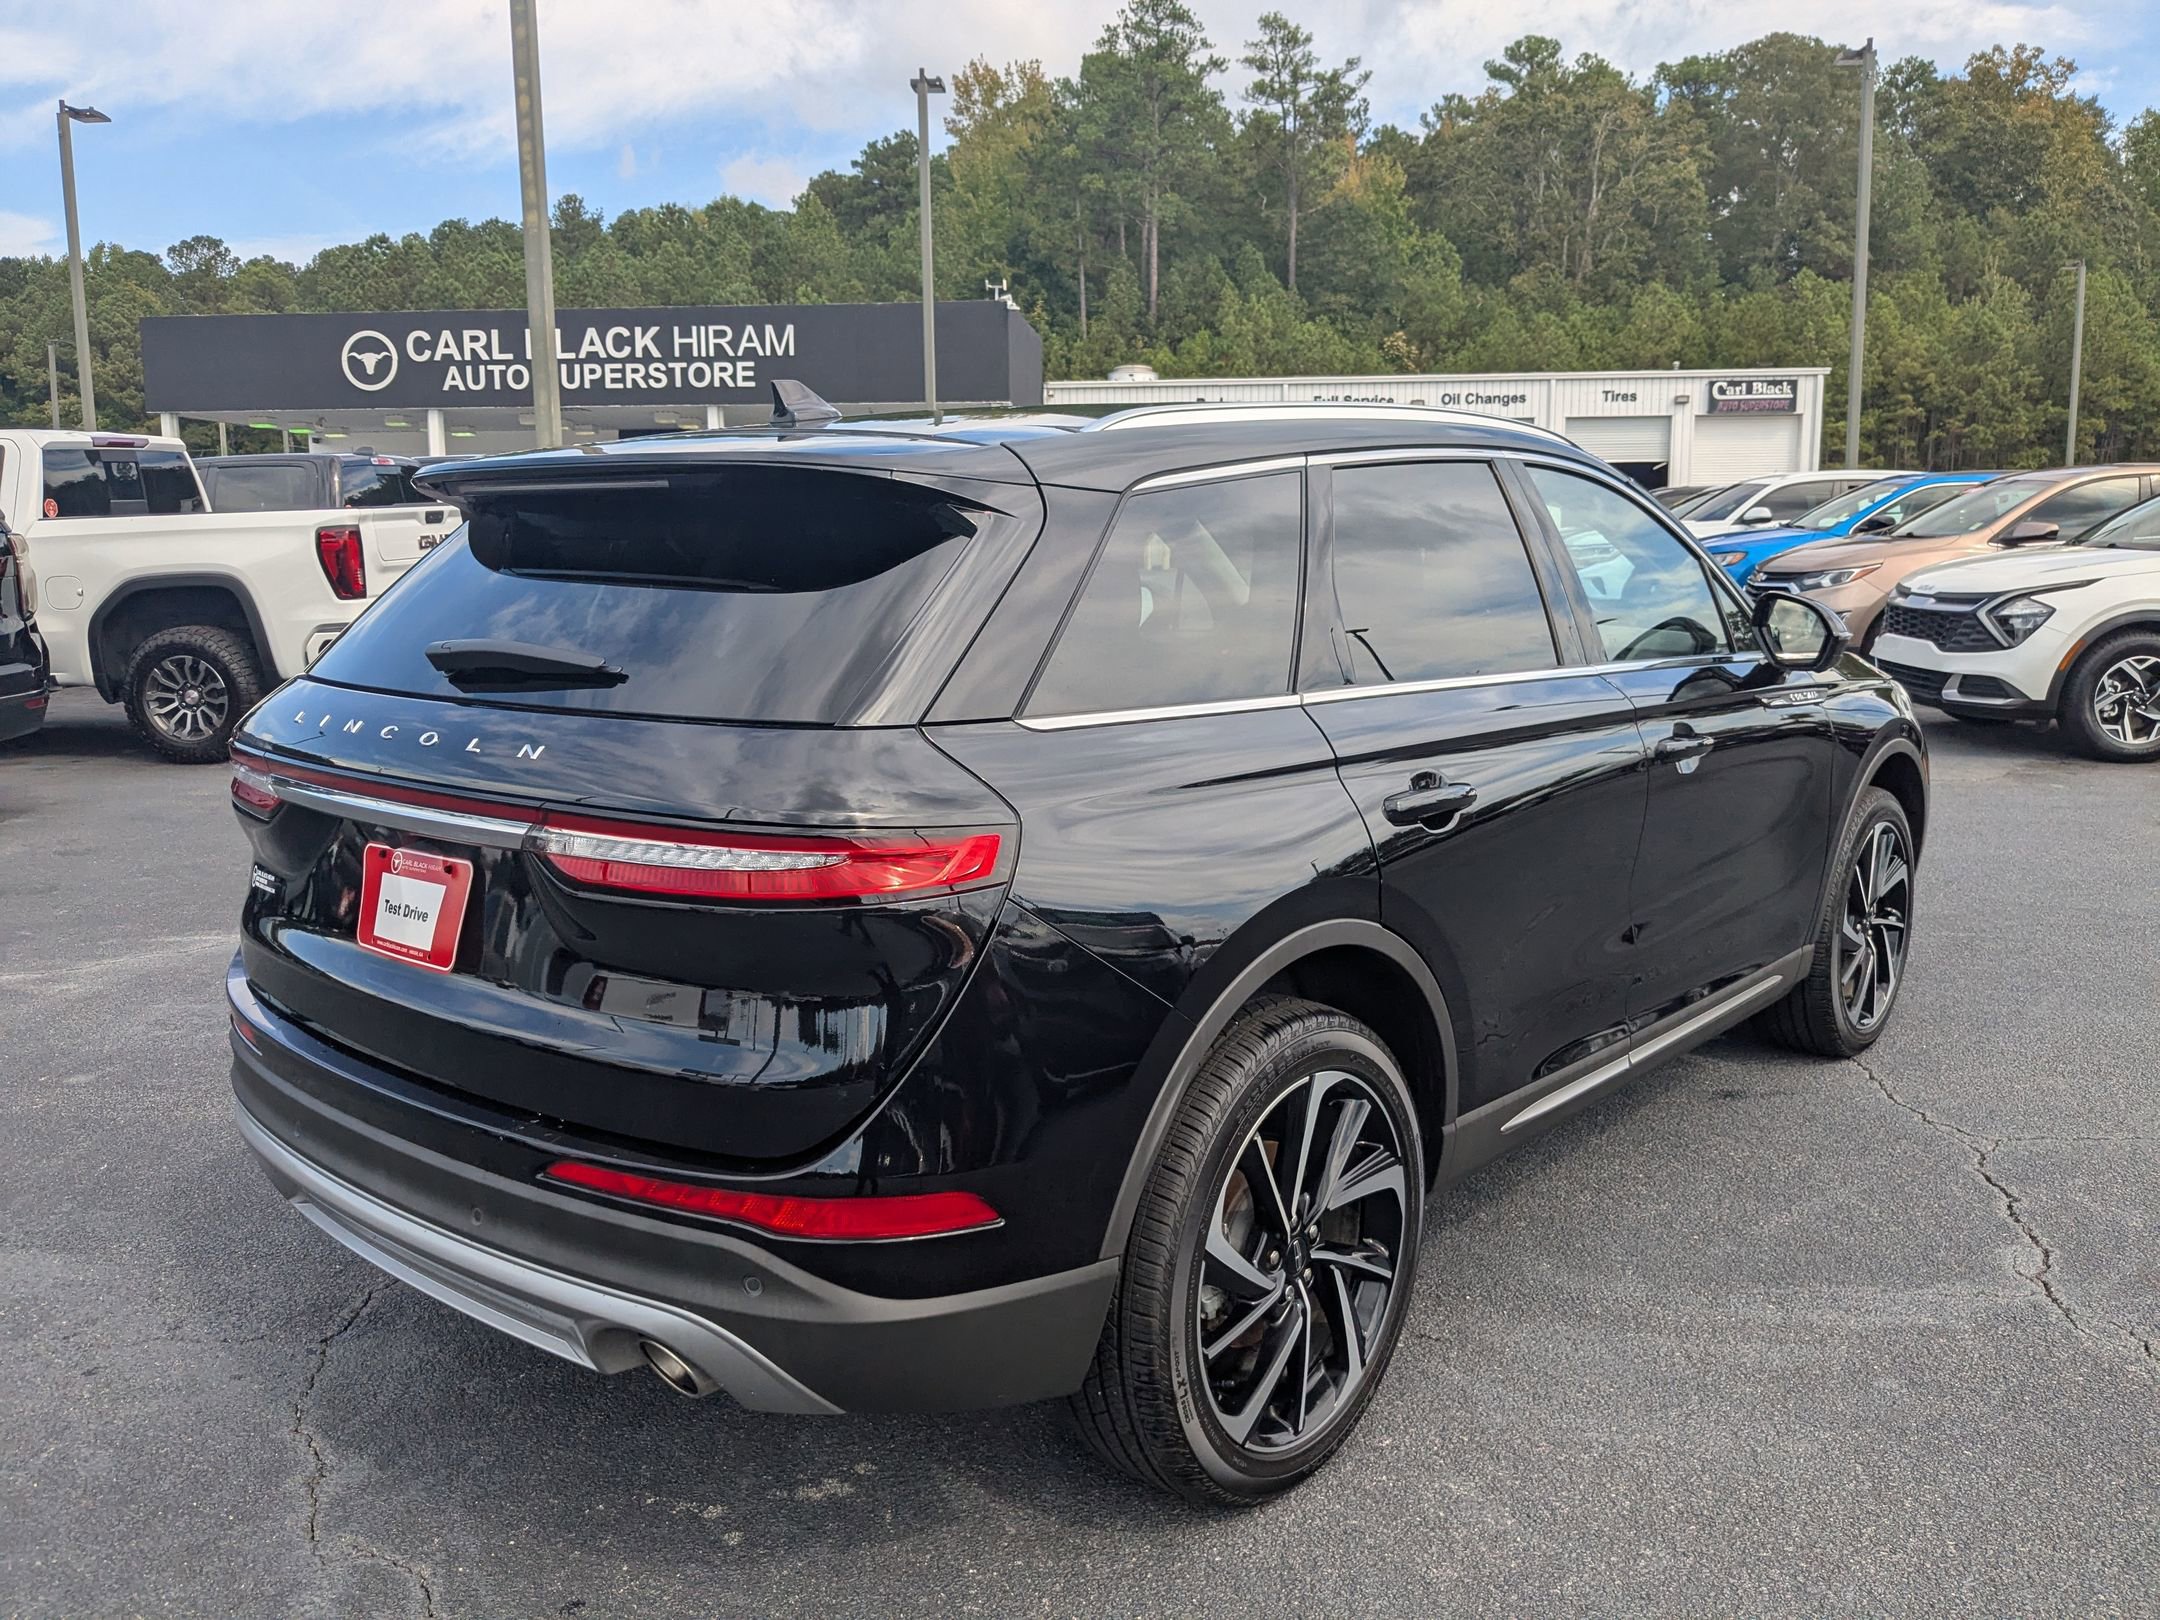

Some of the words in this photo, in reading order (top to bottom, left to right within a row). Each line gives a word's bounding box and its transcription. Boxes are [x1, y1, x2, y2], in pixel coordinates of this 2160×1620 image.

[406, 327, 514, 362] CARL
[525, 326, 660, 360] LACK
[673, 324, 795, 358] HIRAM
[442, 364, 530, 392] AUTO
[560, 361, 755, 390] UPERSTORE
[1441, 393, 1460, 406] Oil
[1464, 392, 1527, 407] Changes
[1602, 390, 1637, 403] Tires
[1712, 381, 1747, 399] Carl
[1752, 381, 1792, 394] Black
[1718, 400, 1739, 411] AUTO
[1740, 399, 1790, 411] SUPERSTORE
[293, 711, 546, 761] LINCOLN
[384, 899, 402, 916] Test
[403, 904, 429, 923] Drive
